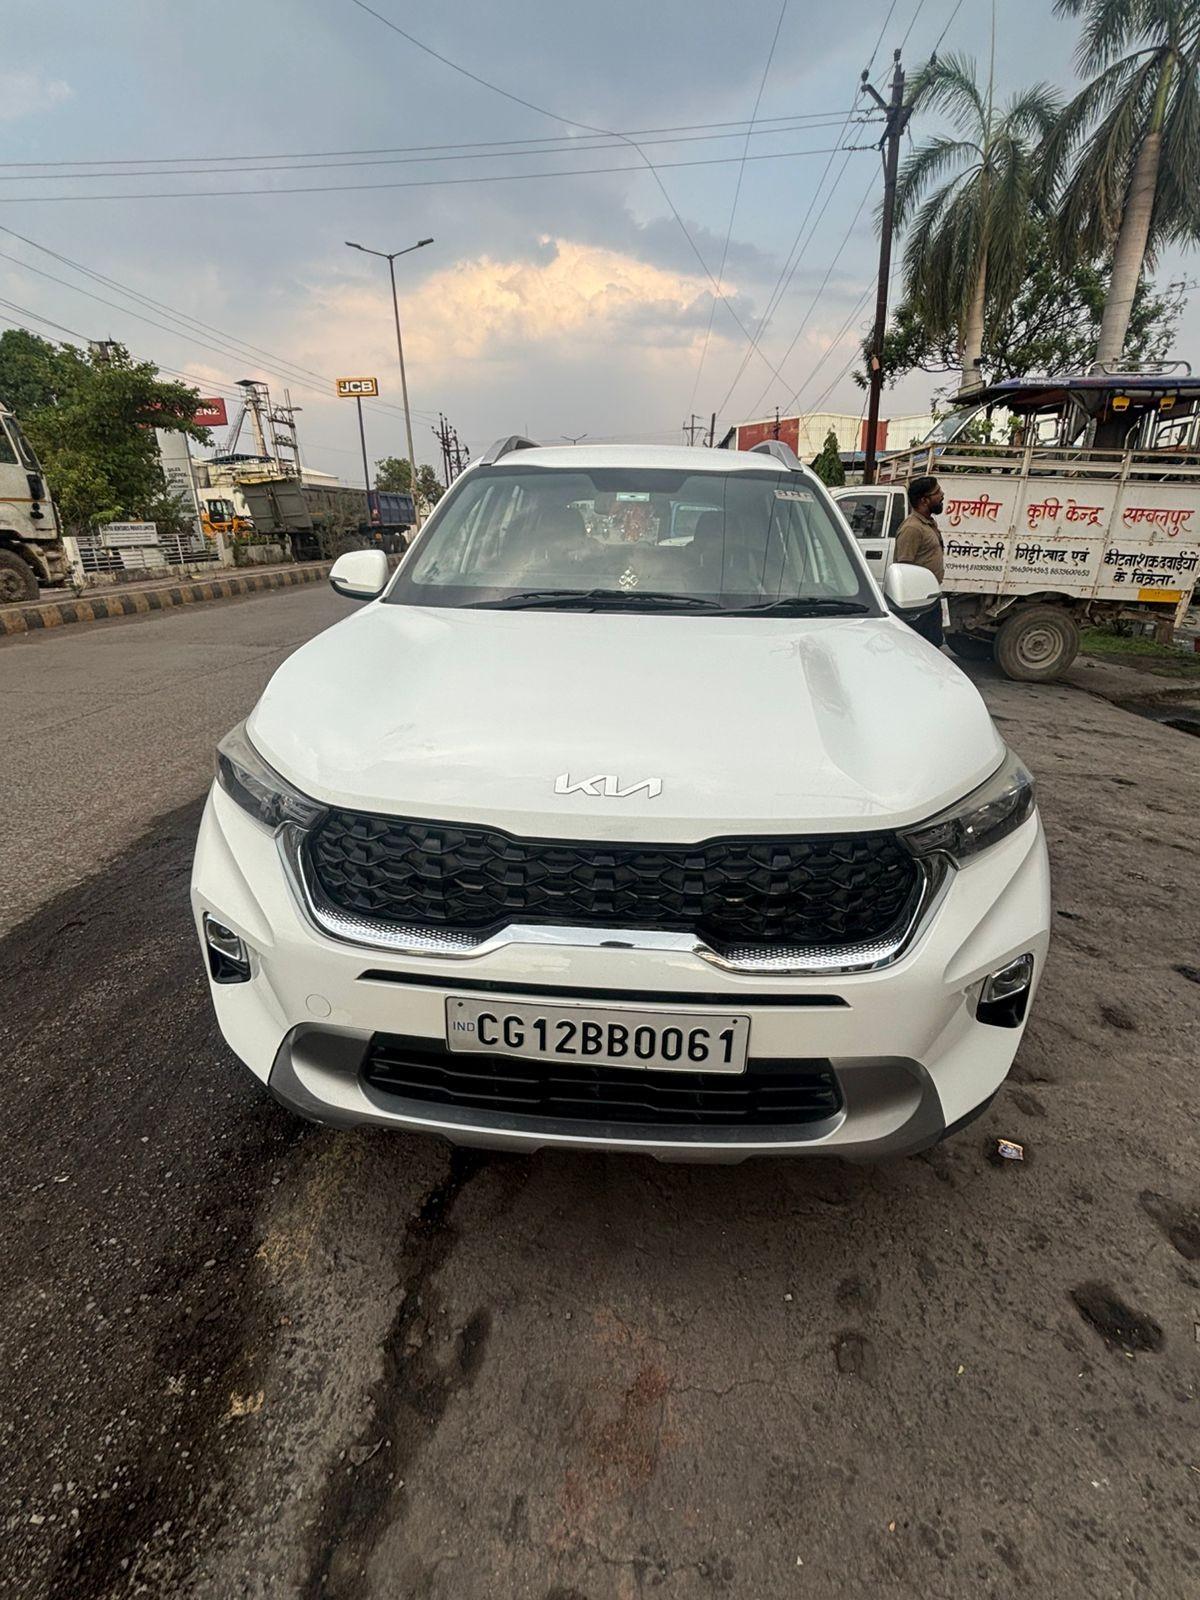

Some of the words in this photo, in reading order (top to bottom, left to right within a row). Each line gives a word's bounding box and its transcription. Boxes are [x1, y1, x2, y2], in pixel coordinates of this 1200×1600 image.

[340, 381, 373, 393] JCB
[945, 494, 1003, 526] गुरमीत
[1027, 497, 1063, 528] कृषि
[1066, 499, 1104, 526] केन्द्र
[1071, 547, 1090, 566] एवं
[1114, 568, 1127, 582] के
[554, 772, 662, 799] KIA
[452, 1021, 475, 1032] IND
[477, 1012, 735, 1064] CG12BB0061
